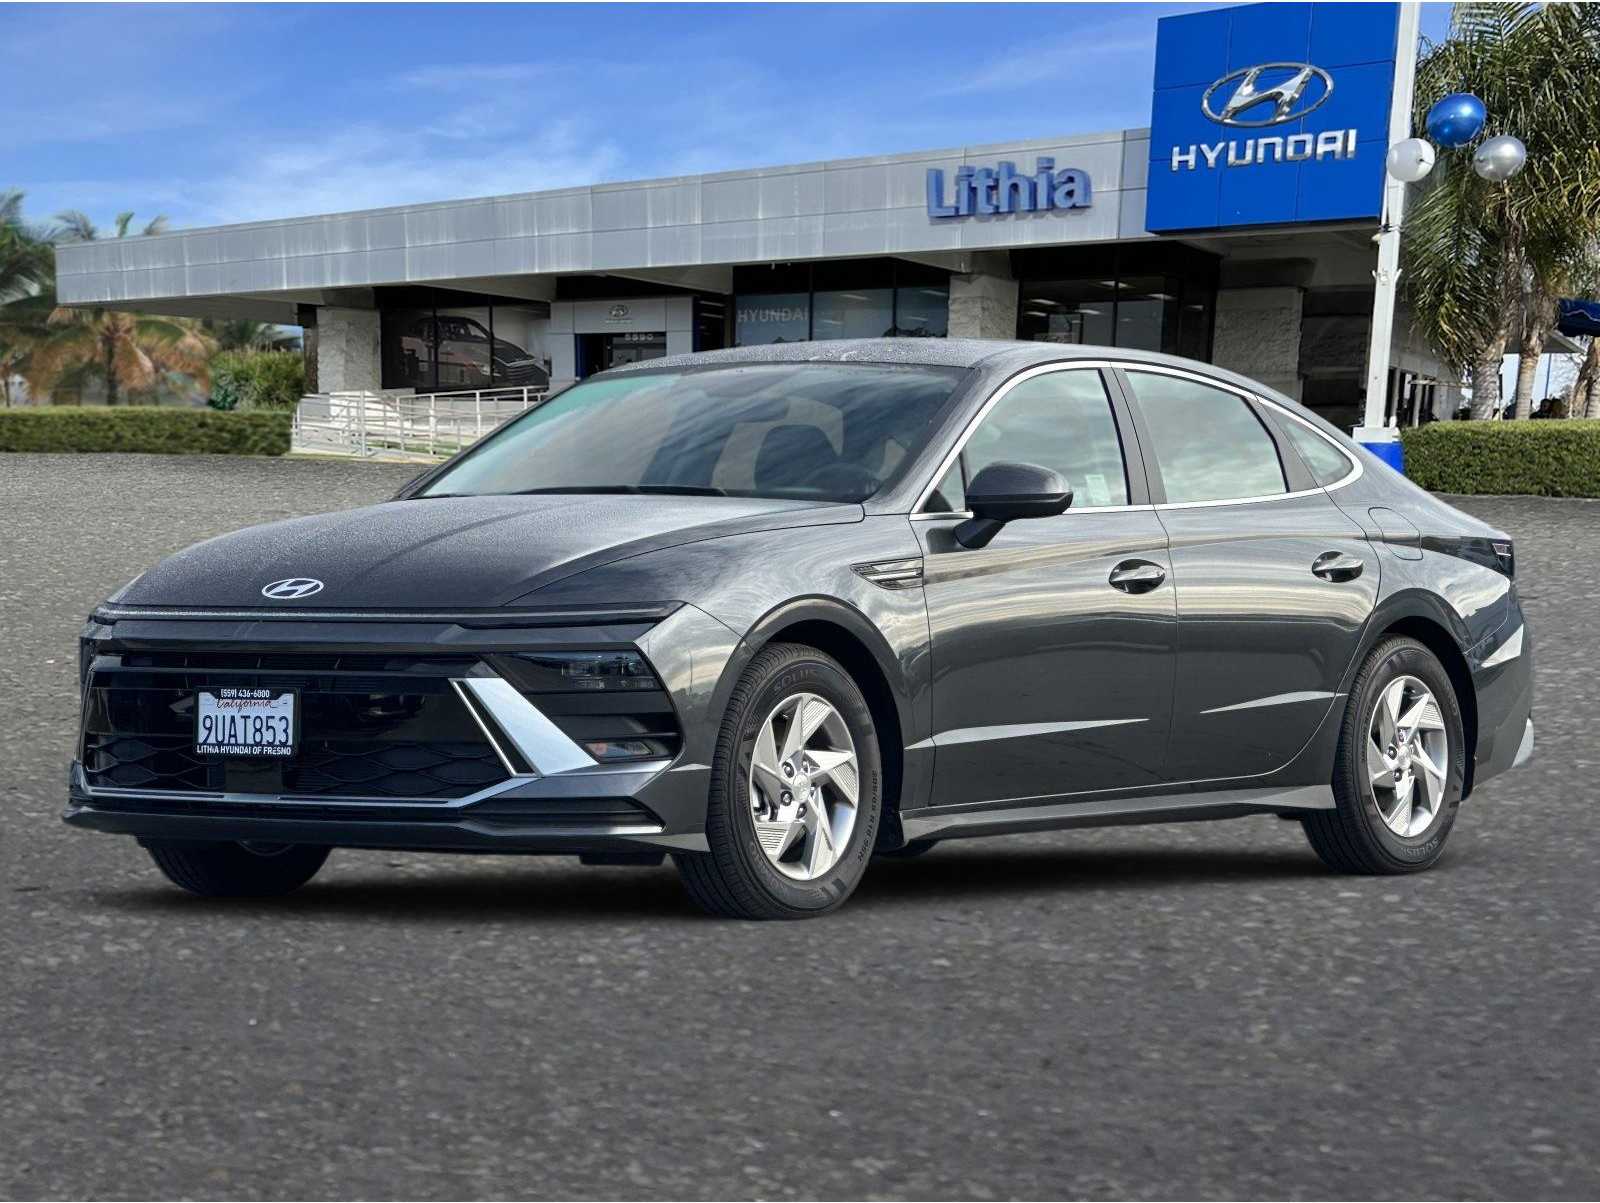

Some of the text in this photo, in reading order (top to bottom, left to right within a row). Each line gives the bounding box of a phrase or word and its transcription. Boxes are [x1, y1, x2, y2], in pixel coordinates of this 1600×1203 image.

[1171, 128, 1357, 171] HYUNDAI
[927, 156, 1092, 218] Lithia
[737, 306, 808, 322] HYUNDAI
[217, 699, 278, 713] California
[202, 714, 290, 745] 9UAT853
[197, 745, 291, 755] LITHIA HYUNDAI OF FRESNO
